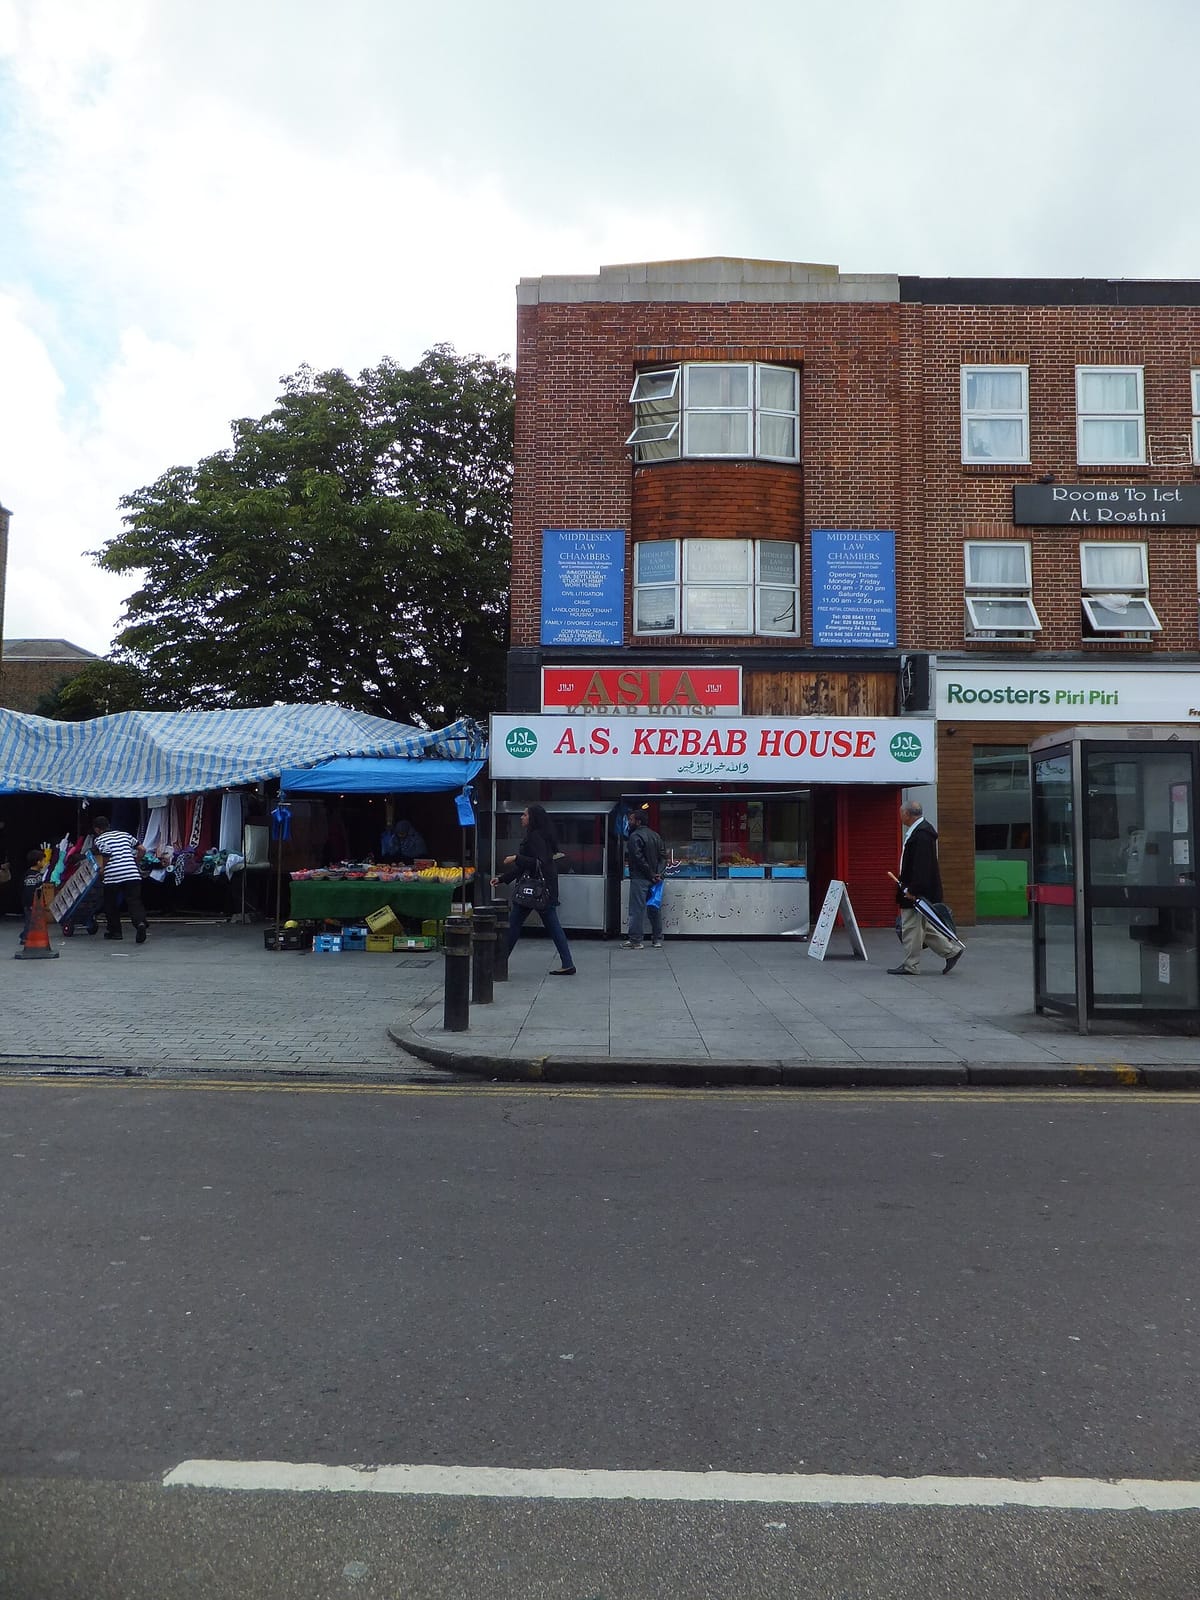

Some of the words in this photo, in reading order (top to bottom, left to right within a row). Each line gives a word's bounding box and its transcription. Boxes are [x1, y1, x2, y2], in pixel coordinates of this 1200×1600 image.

[1052, 488, 1119, 501] Rooms
[1124, 488, 1146, 501] To
[1153, 488, 1183, 502] Let
[1070, 508, 1091, 522] At
[1097, 508, 1166, 522] Roshni
[578, 670, 703, 705] ASIA
[948, 684, 1050, 704] Roosters
[1055, 690, 1084, 704] Piri
[1090, 690, 1118, 705] Piri
[508, 732, 537, 746] حلال
[553, 728, 619, 755] A.S.
[630, 728, 748, 756] KEBAB
[757, 730, 876, 758] HOUSE
[891, 736, 922, 750] حلال
